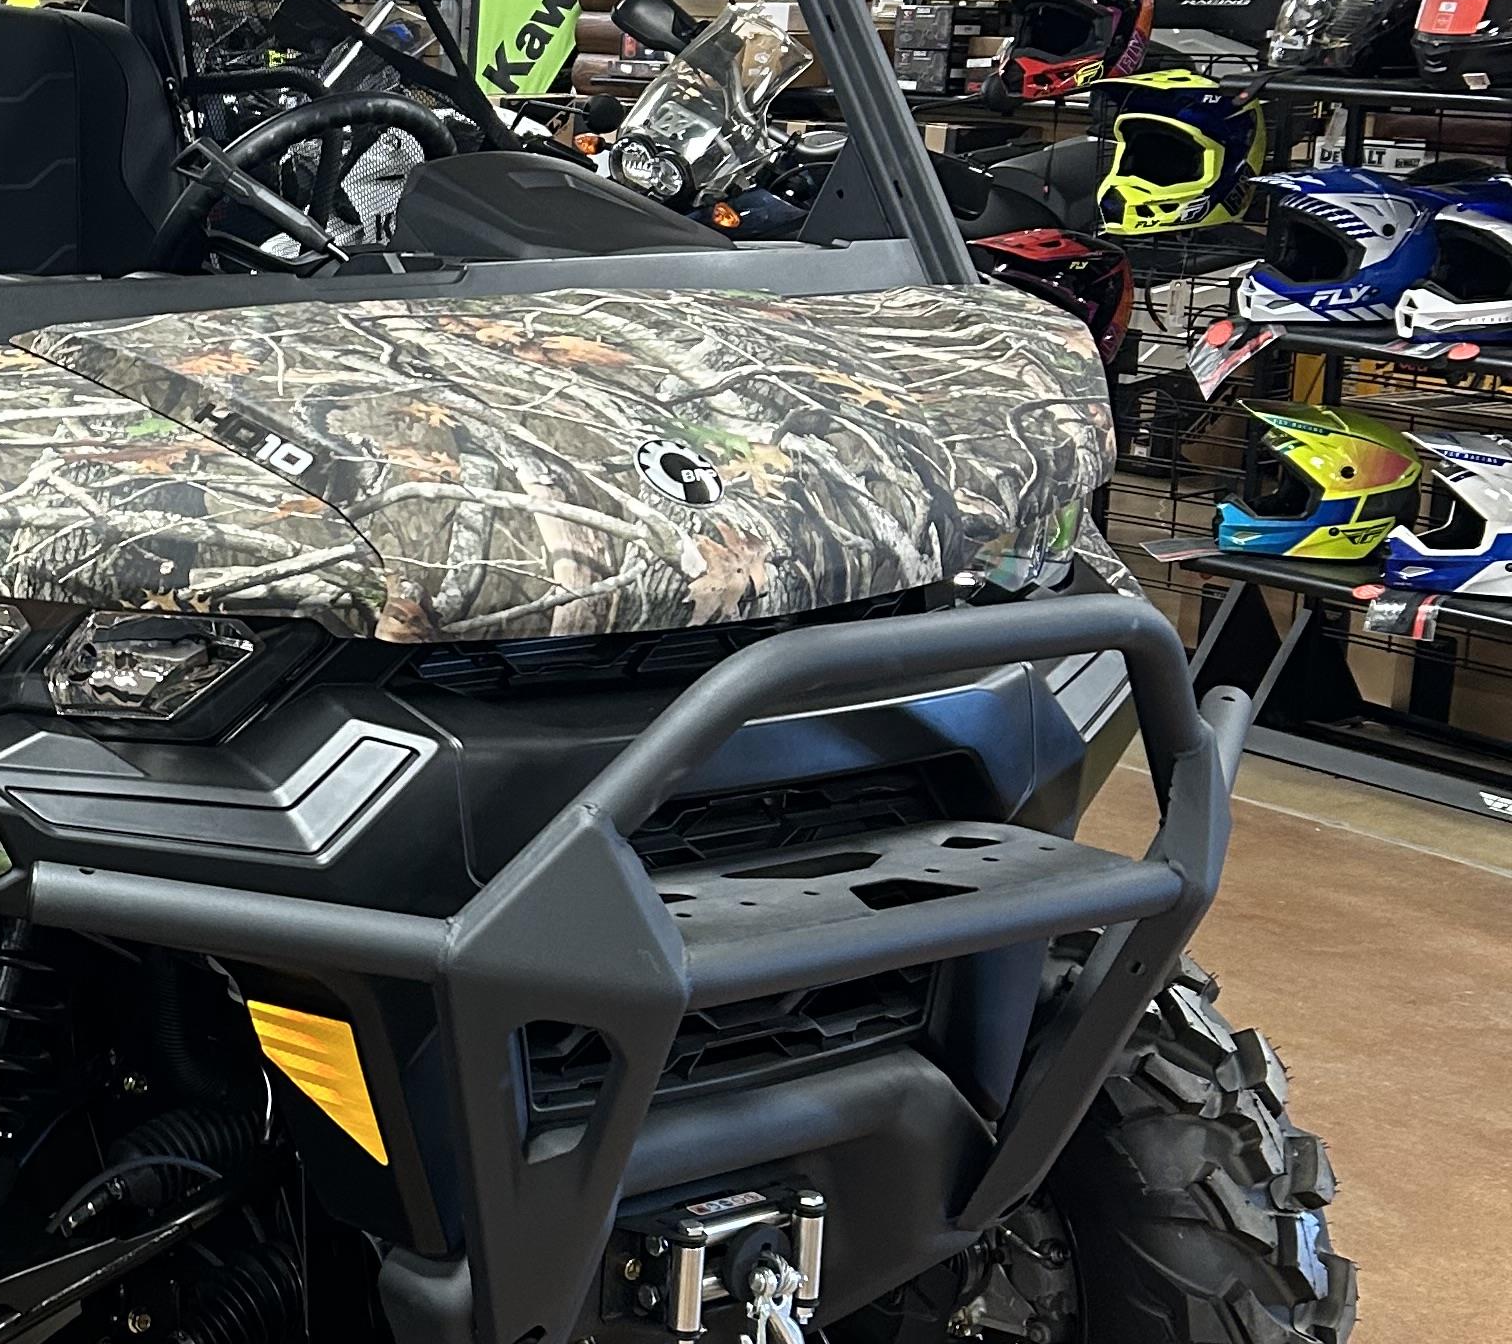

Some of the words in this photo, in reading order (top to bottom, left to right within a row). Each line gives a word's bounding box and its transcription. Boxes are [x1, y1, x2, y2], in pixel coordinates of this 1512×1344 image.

[1202, 93, 1223, 104] FLY
[1134, 219, 1161, 229] FLY
[1069, 260, 1089, 270] FLY
[1309, 284, 1372, 308] FLY
[194, 402, 315, 477] HD10
[681, 468, 719, 484] BRP
